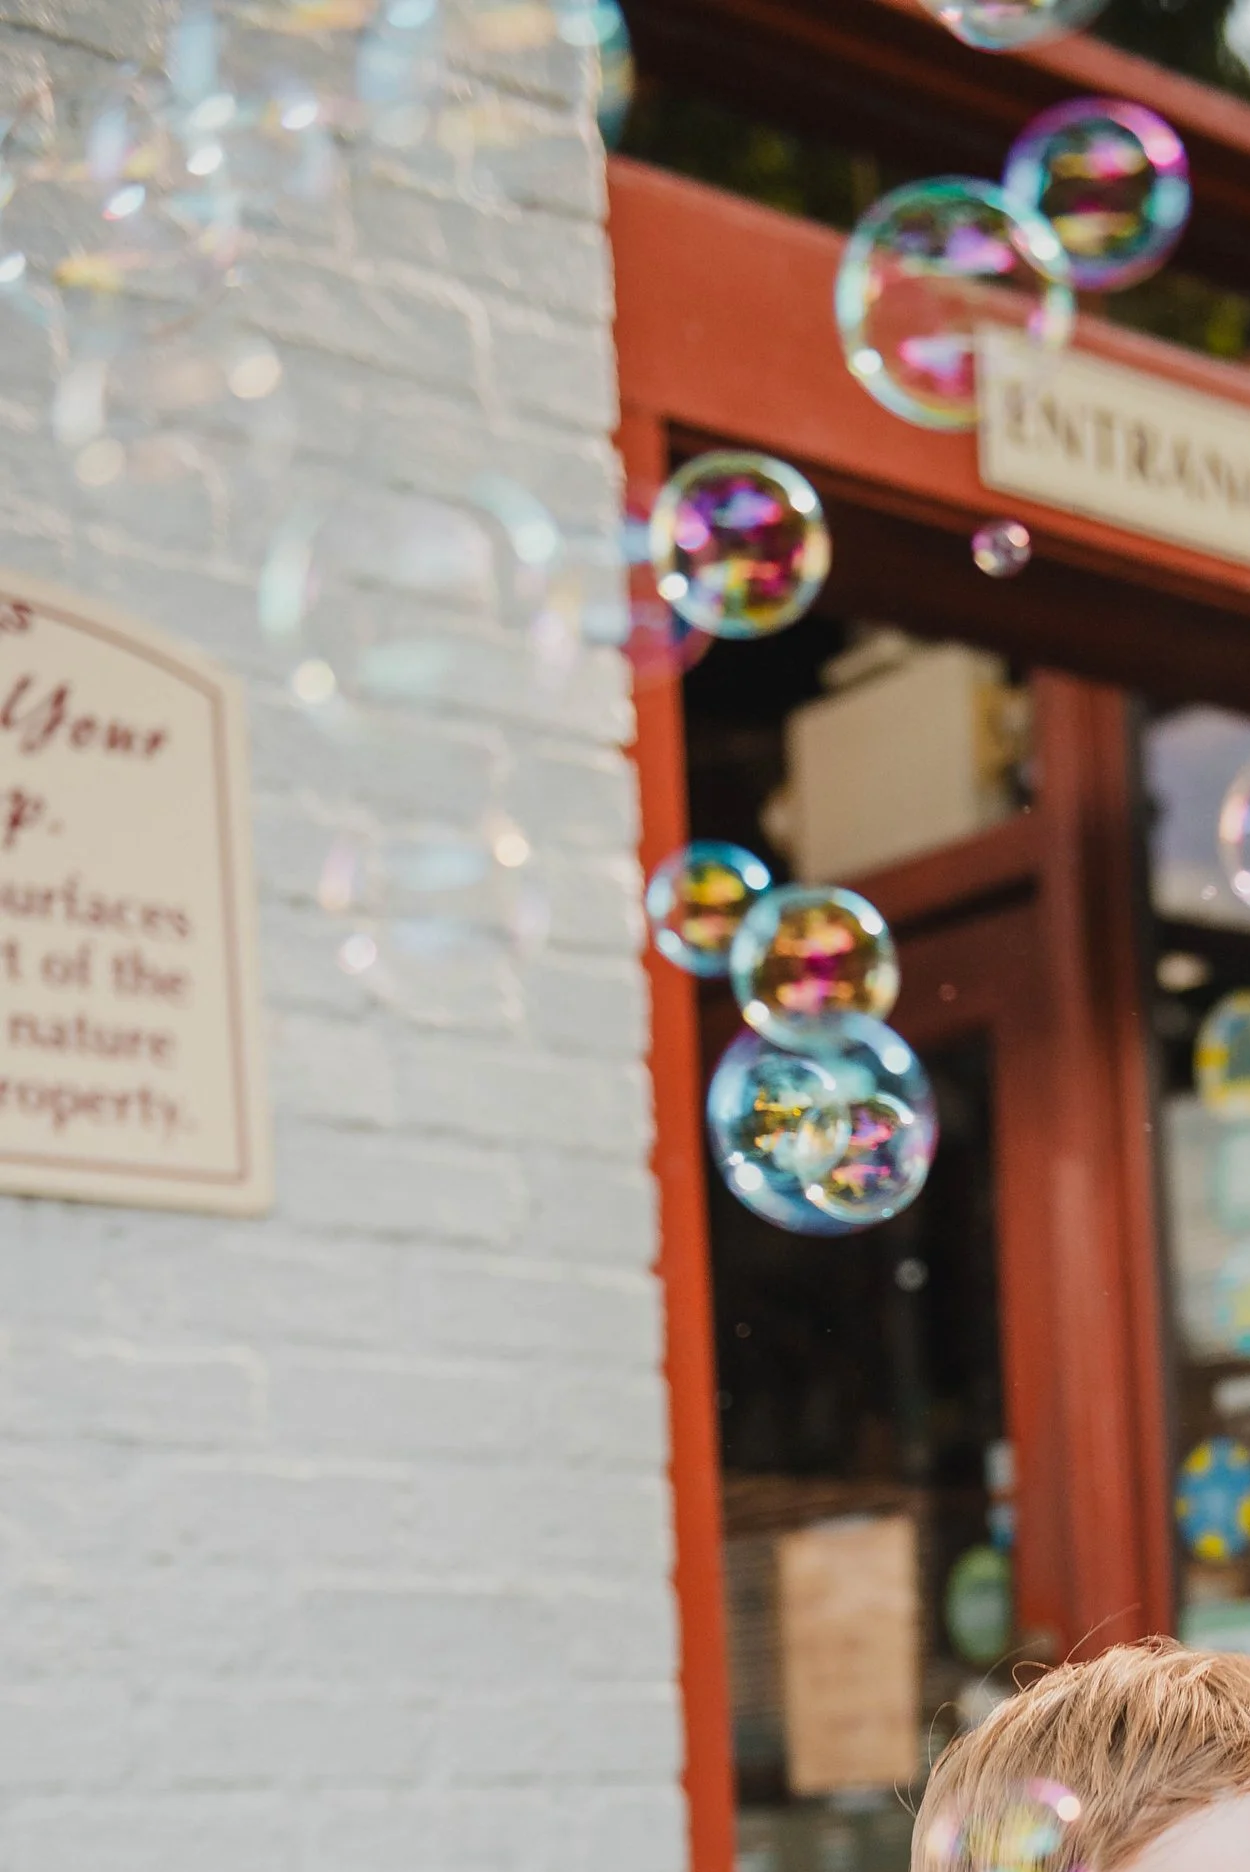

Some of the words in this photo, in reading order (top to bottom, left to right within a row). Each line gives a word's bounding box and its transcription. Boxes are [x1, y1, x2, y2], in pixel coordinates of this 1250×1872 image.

[0, 673, 167, 759] Your
[41, 940, 92, 988] of
[112, 950, 188, 1003] the
[7, 1011, 175, 1067] nature
